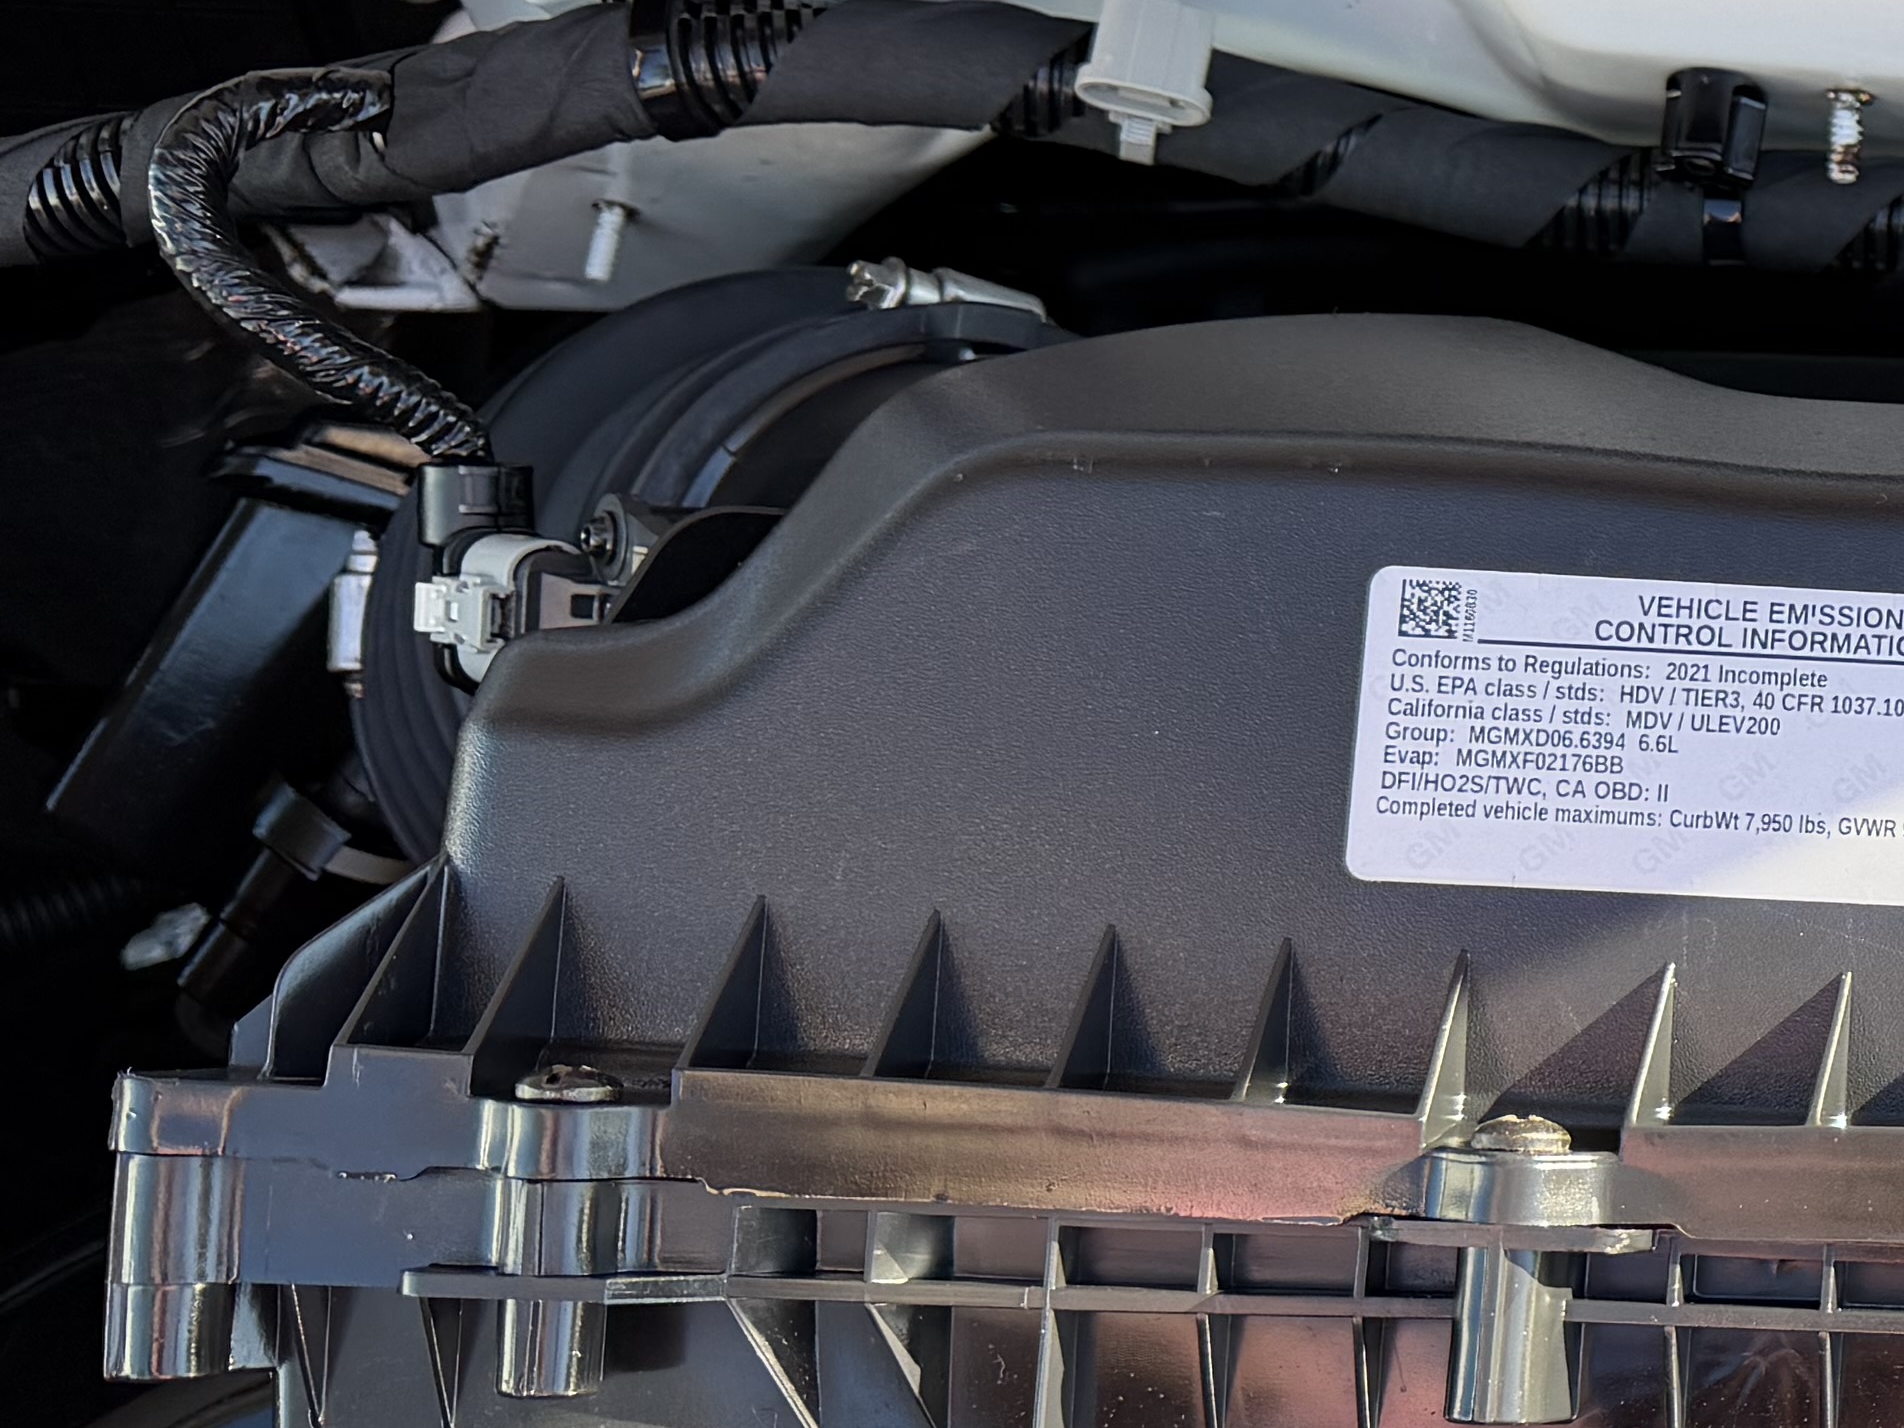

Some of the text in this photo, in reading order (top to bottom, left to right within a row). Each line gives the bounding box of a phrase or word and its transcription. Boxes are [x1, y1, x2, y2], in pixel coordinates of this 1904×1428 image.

[1638, 594, 1904, 631] VEHICLE EMISSION
[1594, 619, 1734, 649] CONTROL
[1391, 648, 1829, 692] Conforms to Regulations: 2021 Incomplete
[1390, 672, 1430, 694] U.S.
[1436, 675, 1478, 696] EPA
[1484, 677, 1537, 699] class
[1542, 679, 1551, 701] /
[1554, 681, 1605, 703] stds:
[1619, 684, 1665, 705] HDV
[1668, 686, 1677, 707] /
[1680, 687, 1745, 713] TIER3,
[1752, 689, 1776, 711] 40
[1781, 692, 1825, 714] CFR
[1387, 697, 1781, 736] California class / stds: MDV / ULEV200
[1385, 721, 1679, 754] Group: MGMXD06.6394 6.6L
[1383, 744, 1624, 775] Evap: MGMXF02176BB
[1380, 770, 1669, 803] DFI/HO2S/TWC, CA OBD: II
[1376, 795, 1477, 822] Completed
[1483, 799, 1549, 822] vehicle
[1554, 804, 1663, 828] maximums:
[1669, 808, 1740, 831] CurbWt
[1745, 812, 1793, 836] 7,950
[1798, 814, 1831, 840] lbs,
[1838, 817, 1897, 838] GVWR
